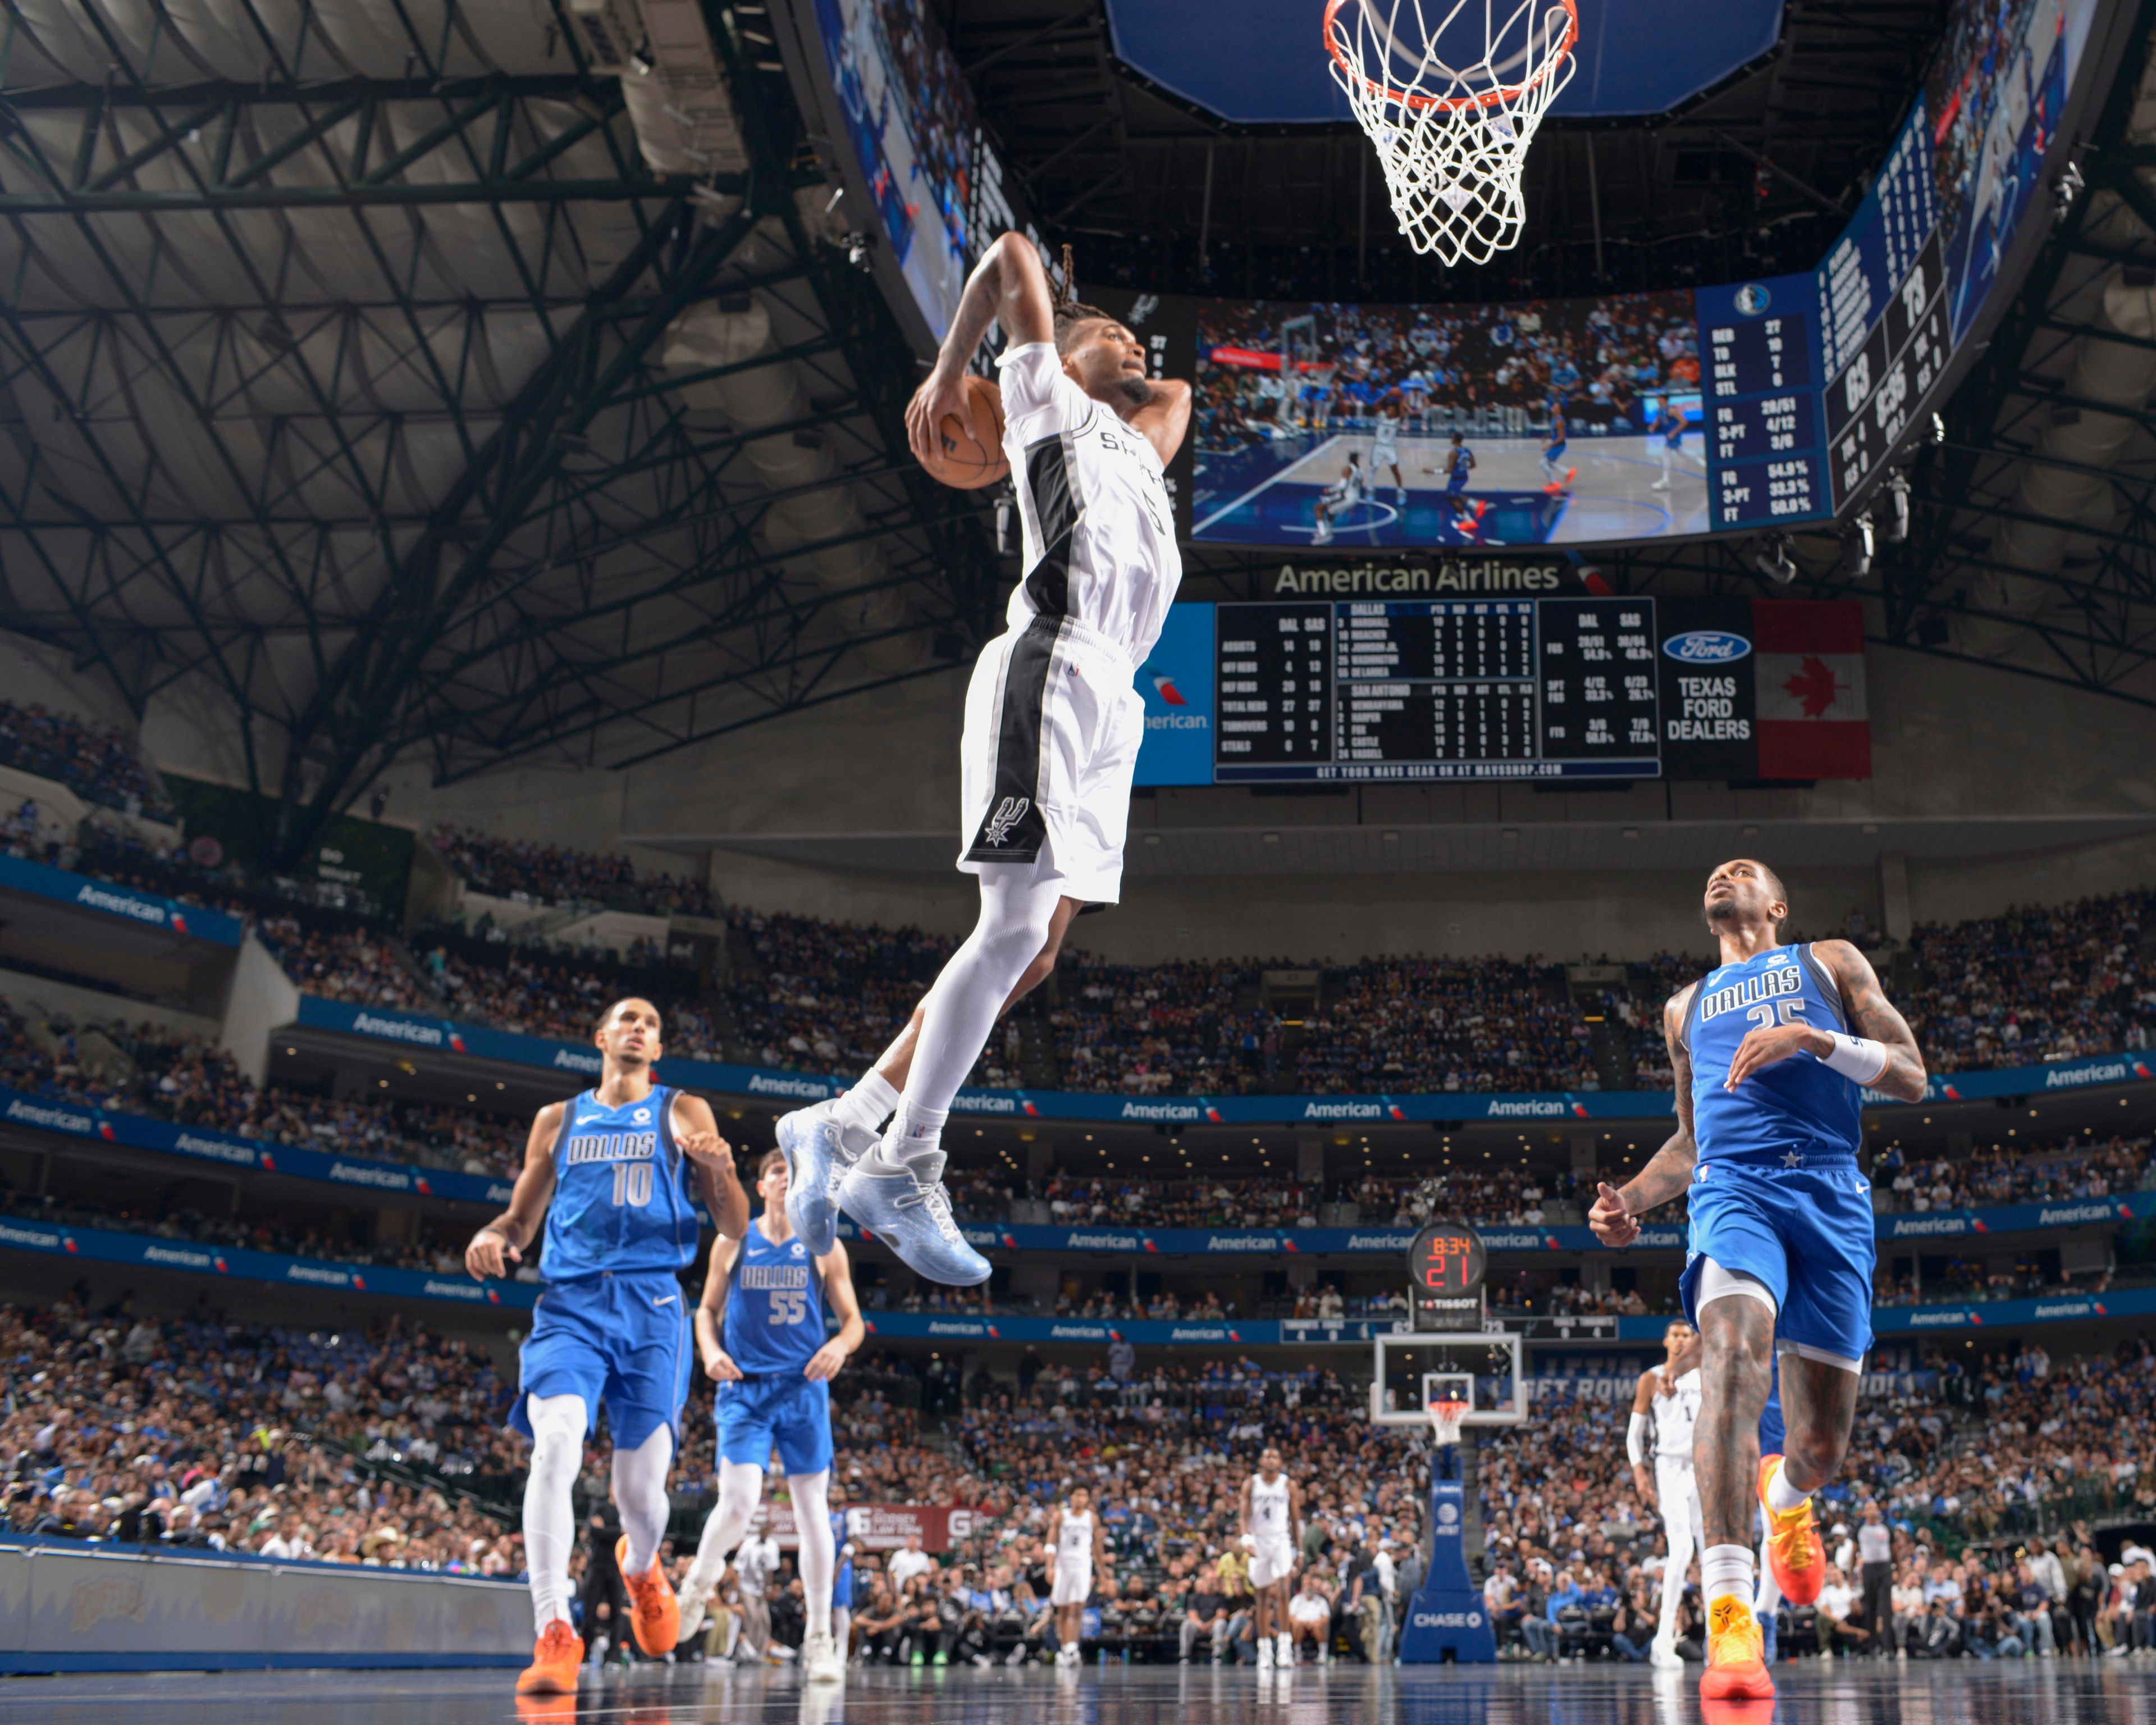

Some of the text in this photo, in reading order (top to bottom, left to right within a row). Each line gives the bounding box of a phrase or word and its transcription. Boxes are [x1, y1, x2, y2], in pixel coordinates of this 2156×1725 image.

[1765, 319, 1782, 335] 27
[1714, 346, 1730, 362] TO
[1771, 354, 1782, 370] 7
[1715, 380, 1737, 397] STL
[1718, 408, 1733, 423] FG
[1719, 415, 1796, 441] 3-PT 4/12
[1720, 443, 1734, 459] FT
[1721, 470, 1737, 486] FG
[1723, 487, 1751, 504] 3-PT
[1724, 506, 1738, 523] FT
[1275, 562, 1560, 593] American Airlines
[1350, 603, 1386, 616] DALLAS
[1578, 613, 1641, 628] DAL SAS
[1679, 636, 1735, 659] Ford
[1678, 677, 1736, 697] TEXAS
[1683, 699, 1733, 719] FORD
[1668, 719, 1751, 740] DEALERS
[1221, 740, 1251, 752] STEALS
[1317, 766, 1336, 779] GET
[1341, 766, 1370, 779] YOUR
[1373, 766, 1404, 779] MAVS
[1408, 766, 1435, 779] GEAR
[1458, 765, 1472, 778] AT
[77, 884, 165, 923] American
[1701, 965, 1802, 1023] DALLAS
[1747, 997, 1808, 1032] 25
[353, 1012, 441, 1045] American
[554, 1048, 603, 1073] Amer
[2046, 1062, 2125, 1088] American
[749, 1075, 828, 1098] American
[7, 1099, 92, 1133] American
[1122, 1101, 1198, 1120] American
[1304, 1101, 1381, 1118] American
[1488, 1099, 1564, 1116] American
[175, 1132, 254, 1164] American
[567, 1131, 656, 1166] DALLAS
[330, 1162, 409, 1189] American
[611, 1162, 654, 1207] 10
[2039, 1204, 2111, 1225] American
[1894, 1218, 1965, 1235] American
[1067, 1232, 1137, 1249] American
[1207, 1235, 1276, 1250] American
[1433, 1237, 1470, 1255] 8:34
[1483, 1233, 1539, 1247] merican
[1631, 1231, 1680, 1247] erican
[144, 1245, 210, 1267] American
[288, 1263, 348, 1285] American
[740, 1265, 809, 1290] DALLAS
[1426, 1255, 1468, 1286] 21
[424, 1280, 483, 1300] American
[768, 1290, 807, 1326] 55
[1434, 1298, 1478, 1309] TISSOT
[2035, 1303, 2089, 1318] American
[1910, 1312, 1965, 1326] American
[928, 1321, 984, 1335] American
[1051, 1324, 1105, 1339] American
[1172, 1327, 1225, 1340] American
[1685, 1405, 1692, 1421] 1
[1262, 1506, 1270, 1519] 4
[1414, 1613, 1465, 1628] CHASE
